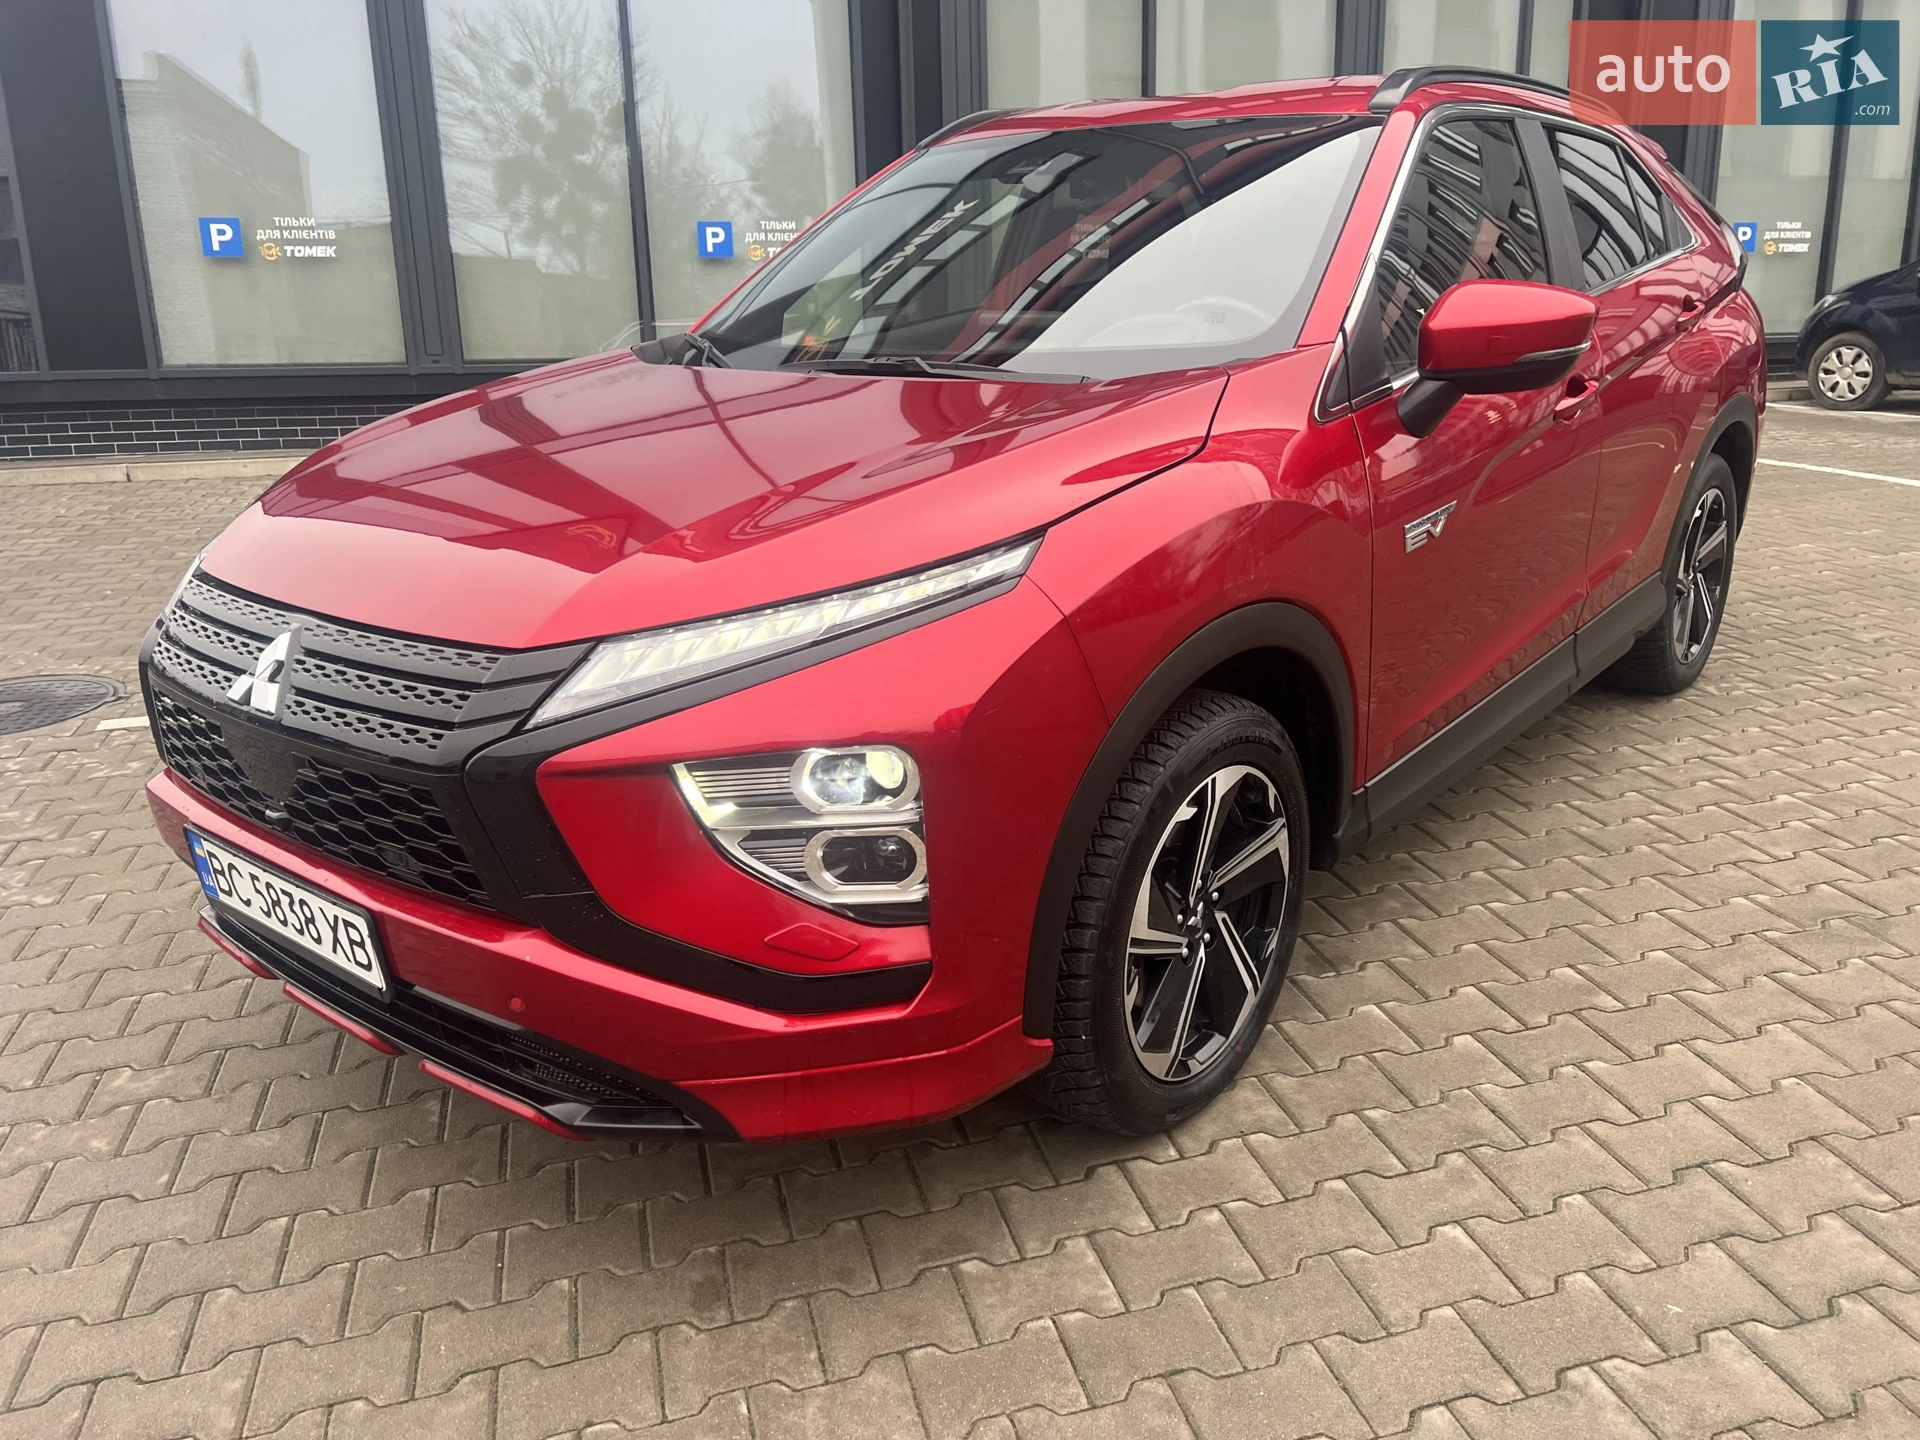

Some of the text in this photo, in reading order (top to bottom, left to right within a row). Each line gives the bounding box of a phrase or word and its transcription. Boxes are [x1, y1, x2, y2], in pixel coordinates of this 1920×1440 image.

[273, 216, 315, 227] ТІЛЬКИ
[760, 220, 796, 230] ТІЛЬКИ
[209, 223, 233, 251] P
[256, 229, 336, 241] ДЛЯ КЛІЄНТІВ
[705, 226, 725, 253] P
[744, 232, 766, 243] ДЛЯ
[1404, 514, 1447, 554] EV
[202, 871, 215, 889] UA
